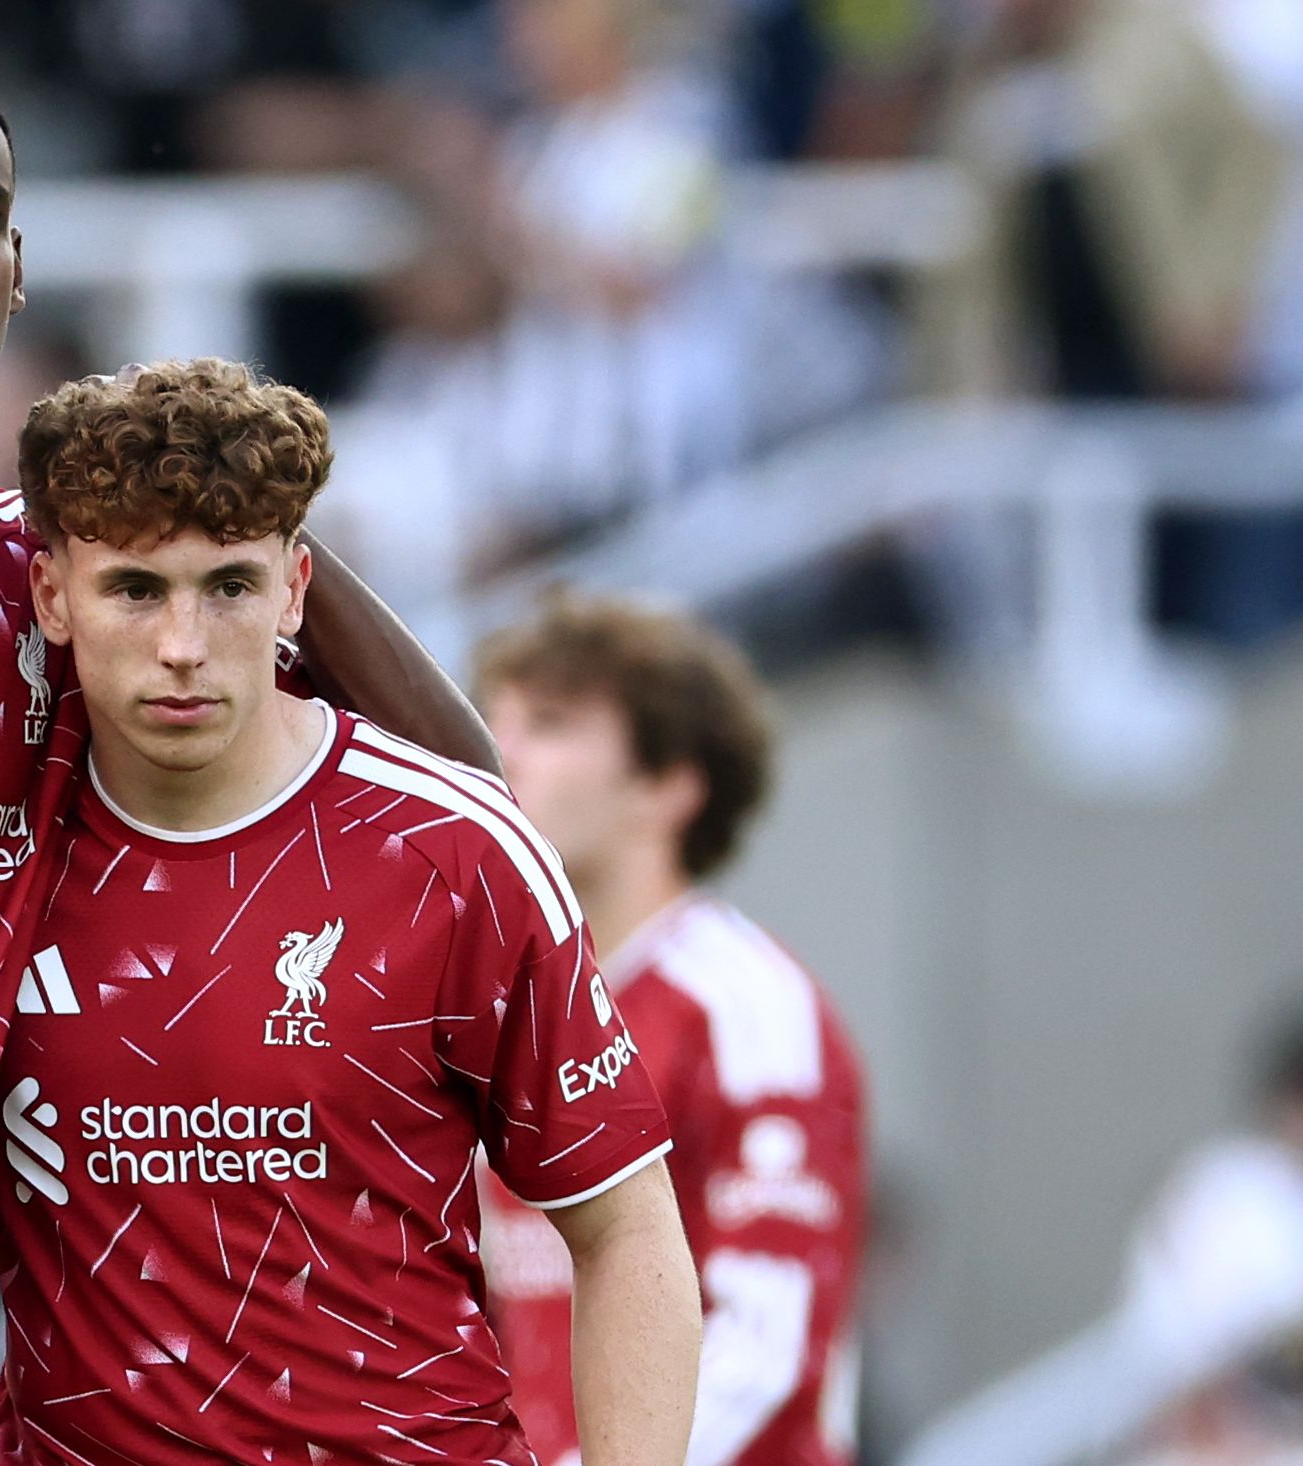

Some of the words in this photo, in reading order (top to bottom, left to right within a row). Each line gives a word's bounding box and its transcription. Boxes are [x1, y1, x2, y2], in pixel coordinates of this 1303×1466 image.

[263, 1019, 331, 1047] L.F.C.
[81, 1097, 312, 1140] standard
[86, 1141, 327, 1184] chartered
